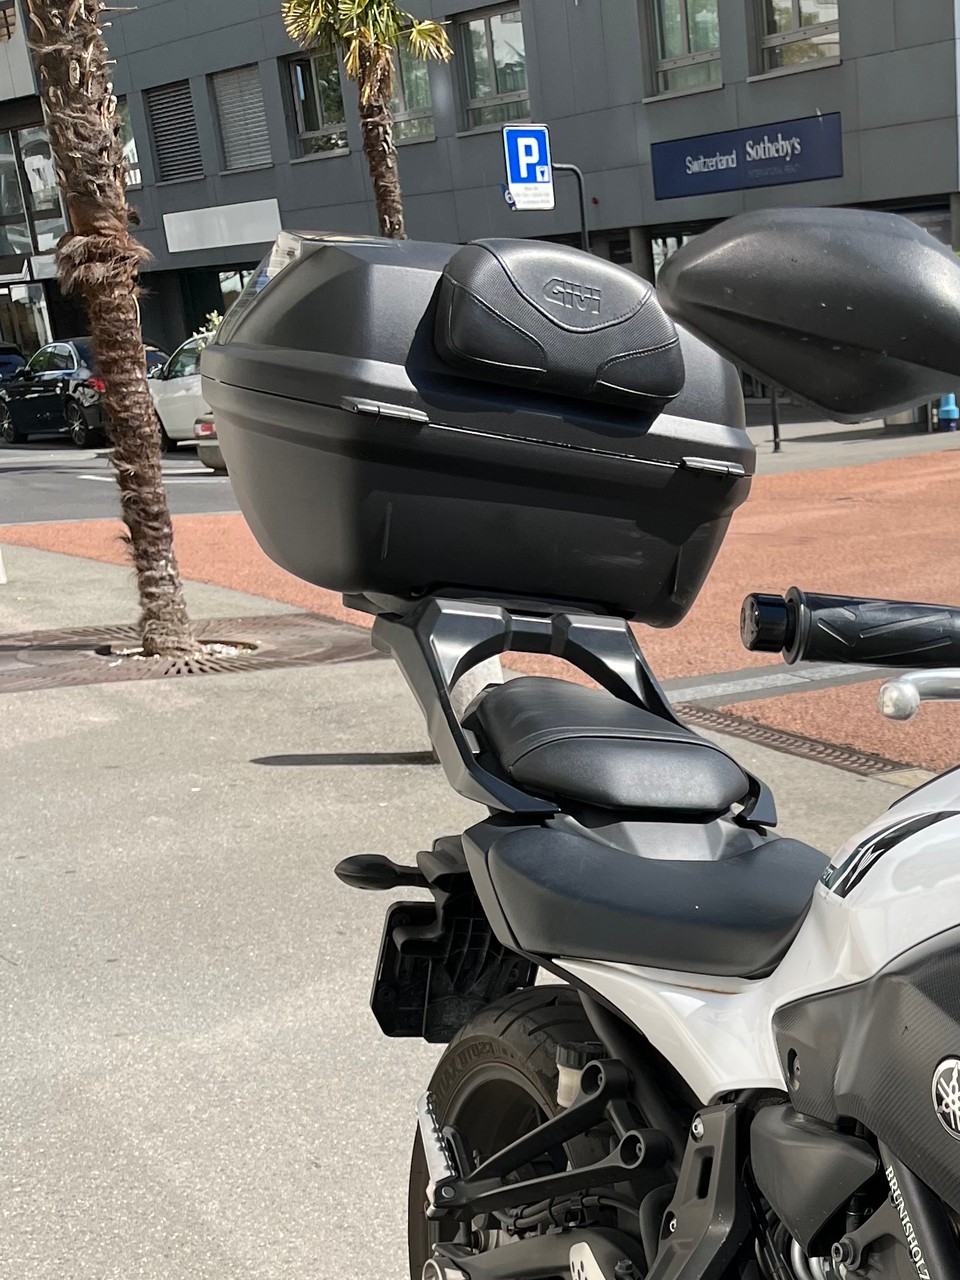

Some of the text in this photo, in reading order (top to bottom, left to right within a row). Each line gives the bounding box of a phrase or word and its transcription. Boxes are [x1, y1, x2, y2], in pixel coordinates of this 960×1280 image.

[517, 137, 540, 178] P
[685, 149, 737, 175] Switzerland
[745, 132, 802, 162] Sotheby's
[542, 277, 601, 315] GIVI
